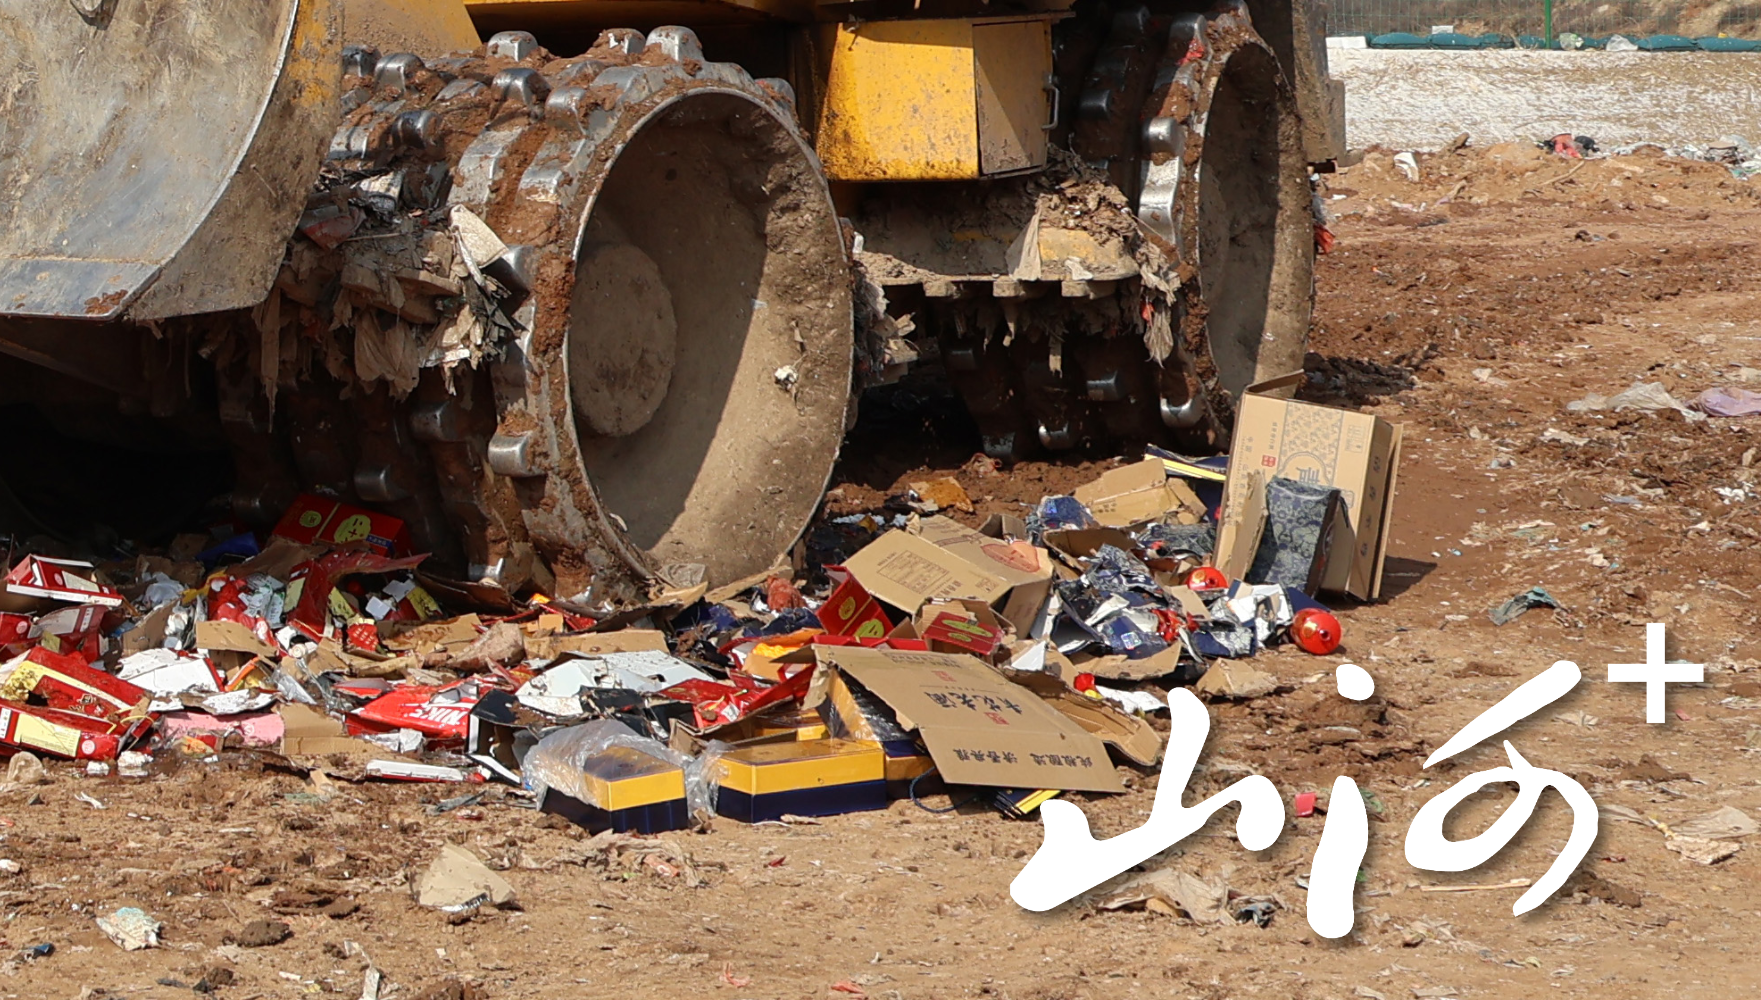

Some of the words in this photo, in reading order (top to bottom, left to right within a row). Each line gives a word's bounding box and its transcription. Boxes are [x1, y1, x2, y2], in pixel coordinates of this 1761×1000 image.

[923, 690, 1025, 717] 青花老酒
[408, 706, 469, 727] NIKE
[952, 748, 1018, 765] 清香典雅
[1029, 751, 1093, 769] 纯粮酿造
